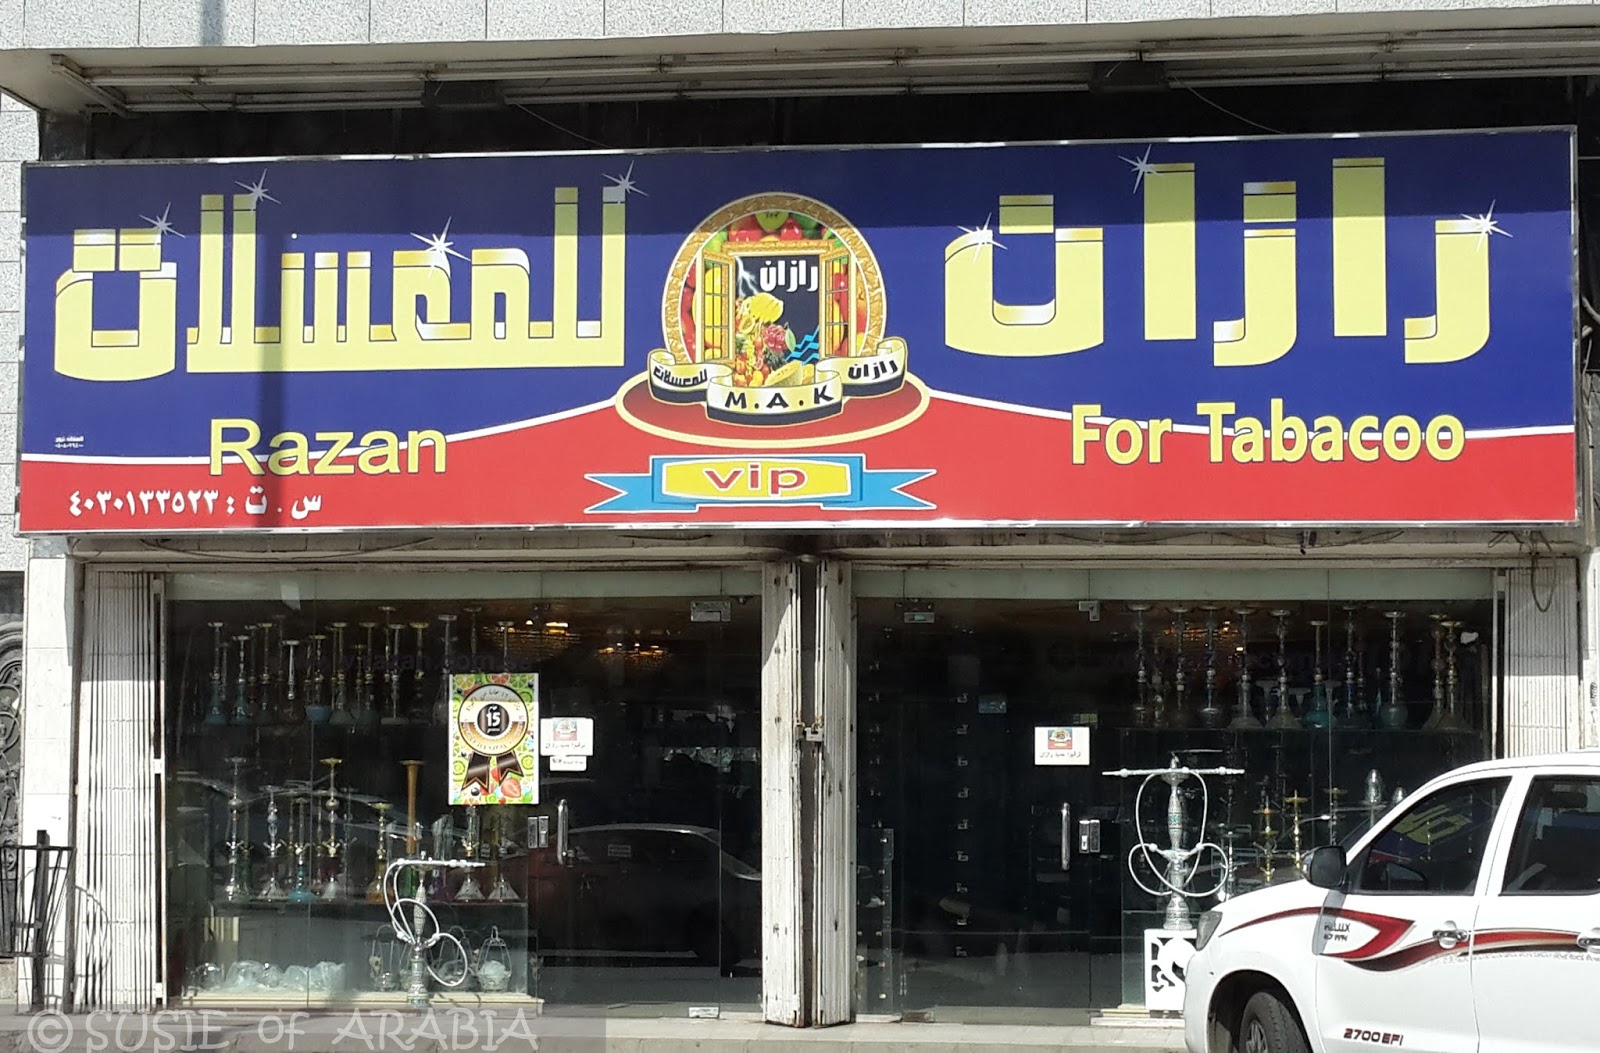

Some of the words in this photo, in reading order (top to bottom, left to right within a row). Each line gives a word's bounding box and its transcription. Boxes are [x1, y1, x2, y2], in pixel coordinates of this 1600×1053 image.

[759, 260, 819, 291] رازان
[944, 157, 1490, 367] رازان
[54, 186, 626, 381] للمعسلات
[848, 360, 899, 380] رازان
[209, 418, 447, 476] Razan
[1071, 404, 1173, 465] For
[1196, 398, 1466, 464] Tabacoo
[703, 462, 808, 497] vip
[69, 489, 219, 517] ٤٠٣٠١٣٣٥٢٣
[486, 711, 501, 727] 15
